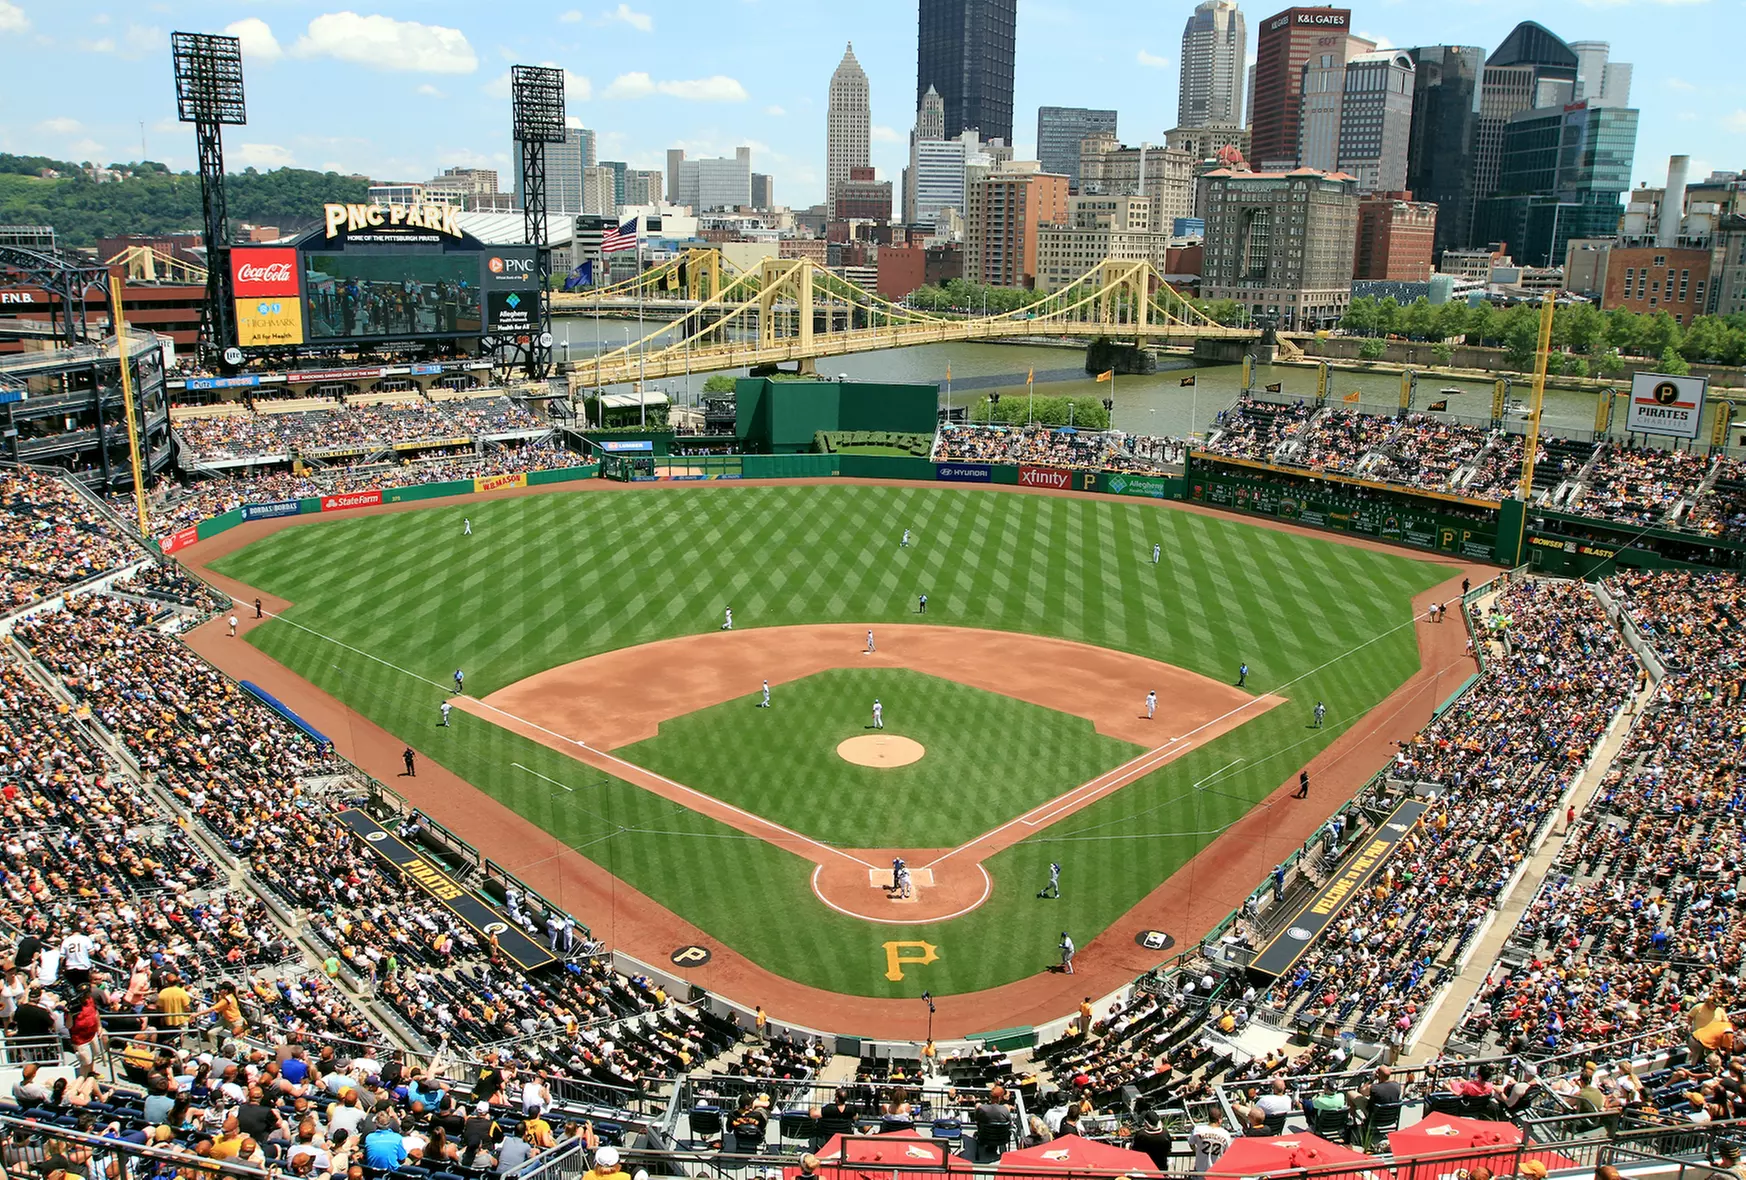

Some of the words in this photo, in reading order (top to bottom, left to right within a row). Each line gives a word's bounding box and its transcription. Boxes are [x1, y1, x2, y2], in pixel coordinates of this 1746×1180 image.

[1277, 16, 1288, 27] GATES
[1298, 15, 1314, 24] K&L
[1316, 16, 1344, 24] GATES
[1318, 36, 1338, 46] EQT
[324, 203, 385, 239] PNC
[390, 204, 463, 239] PARK
[504, 259, 534, 272] PNC
[238, 263, 292, 282] Coca-Cola
[2, 292, 34, 303] F.N.B.
[246, 318, 295, 328] HIGHMARK
[226, 350, 240, 360] Lite
[1661, 386, 1673, 401] P
[1638, 407, 1688, 420] PIRATES
[1637, 416, 1688, 428] CHARITIES
[1022, 470, 1068, 488] xfinity
[1084, 474, 1096, 489] P
[1130, 480, 1164, 490] Allegheny
[250, 506, 272, 514] BORDAS
[275, 503, 297, 511] BORDAS
[1443, 532, 1453, 545] P
[1463, 531, 1471, 541] P
[1533, 538, 1564, 549] BOWSER
[1584, 547, 1614, 558] BLASTS
[402, 860, 463, 900] PIRATES
[1310, 878, 1356, 914] WELCOME
[1350, 856, 1375, 872] PNC
[1363, 840, 1391, 858] PARK
[69, 943, 80, 953] 21
[673, 946, 707, 962] P
[882, 940, 940, 981] P
[527, 1132, 538, 1145] 21
[1202, 1141, 1221, 1156] 22
